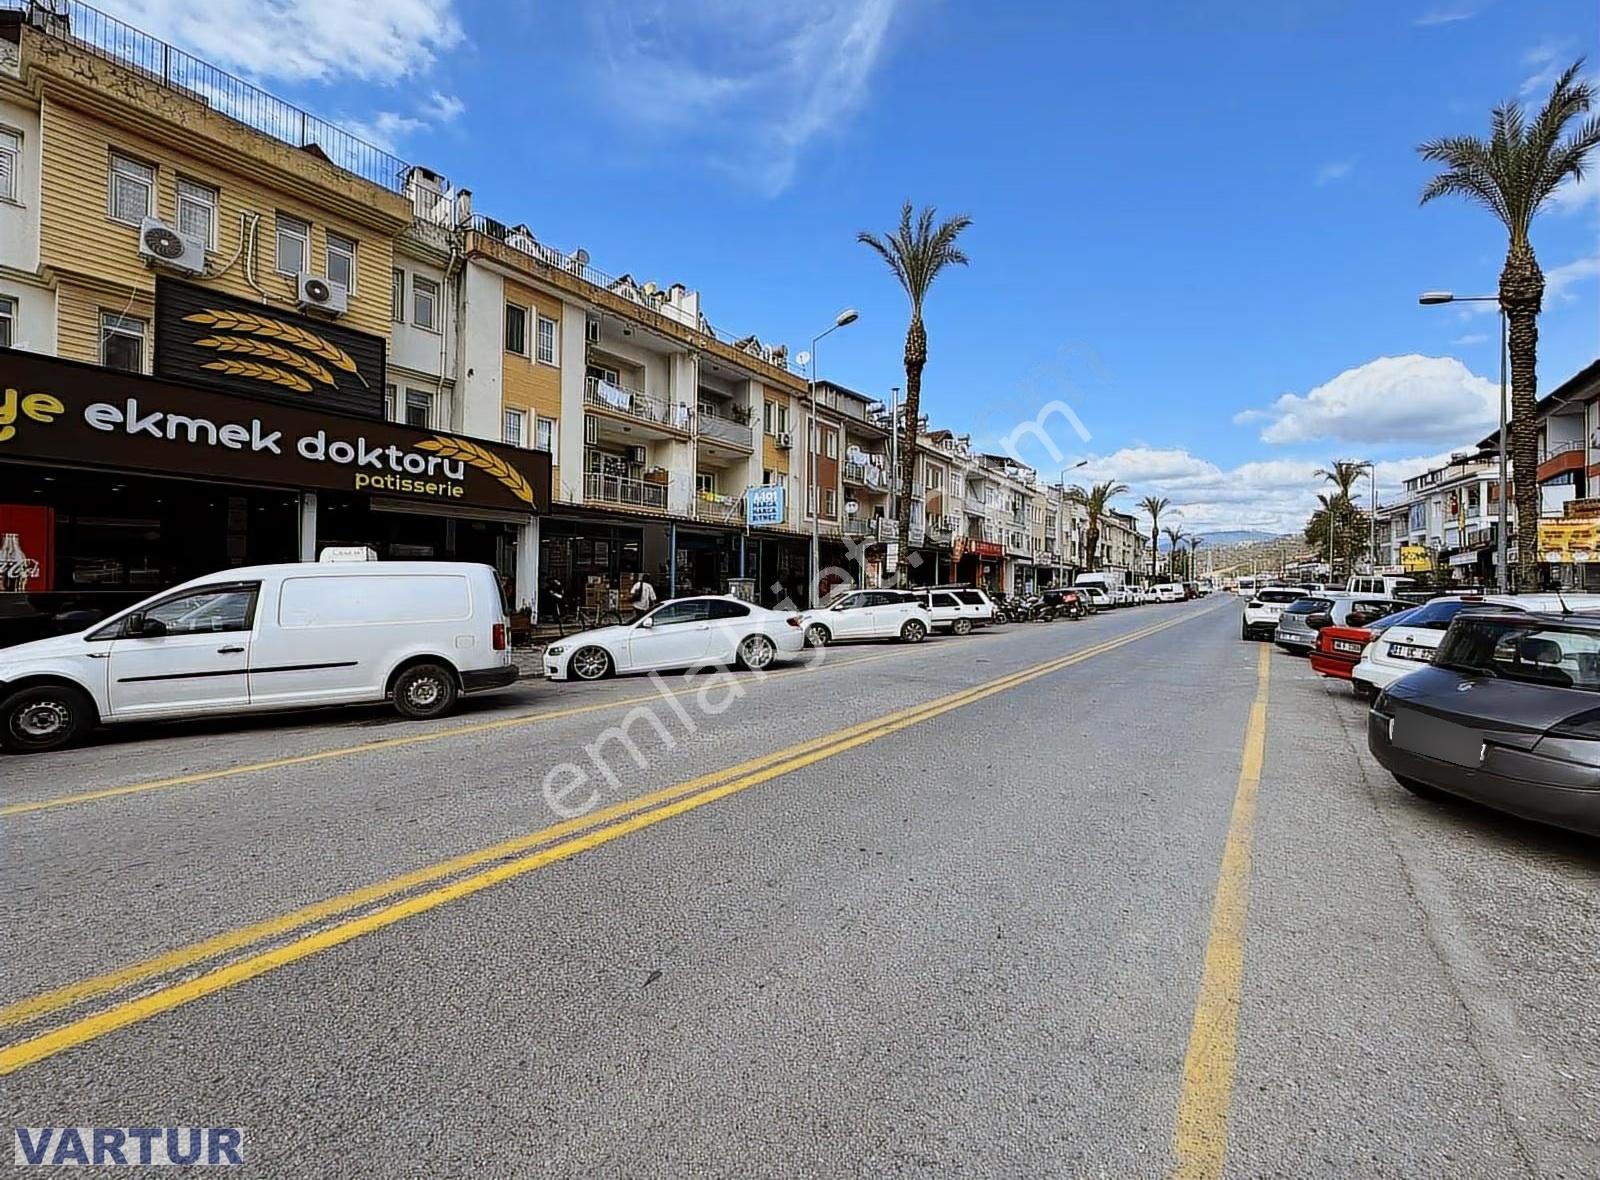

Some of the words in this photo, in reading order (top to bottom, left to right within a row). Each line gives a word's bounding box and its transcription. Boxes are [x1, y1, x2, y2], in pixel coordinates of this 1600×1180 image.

[84, 398, 281, 454] ekmek
[297, 430, 464, 481] doktoru
[355, 472, 464, 498] patisserie
